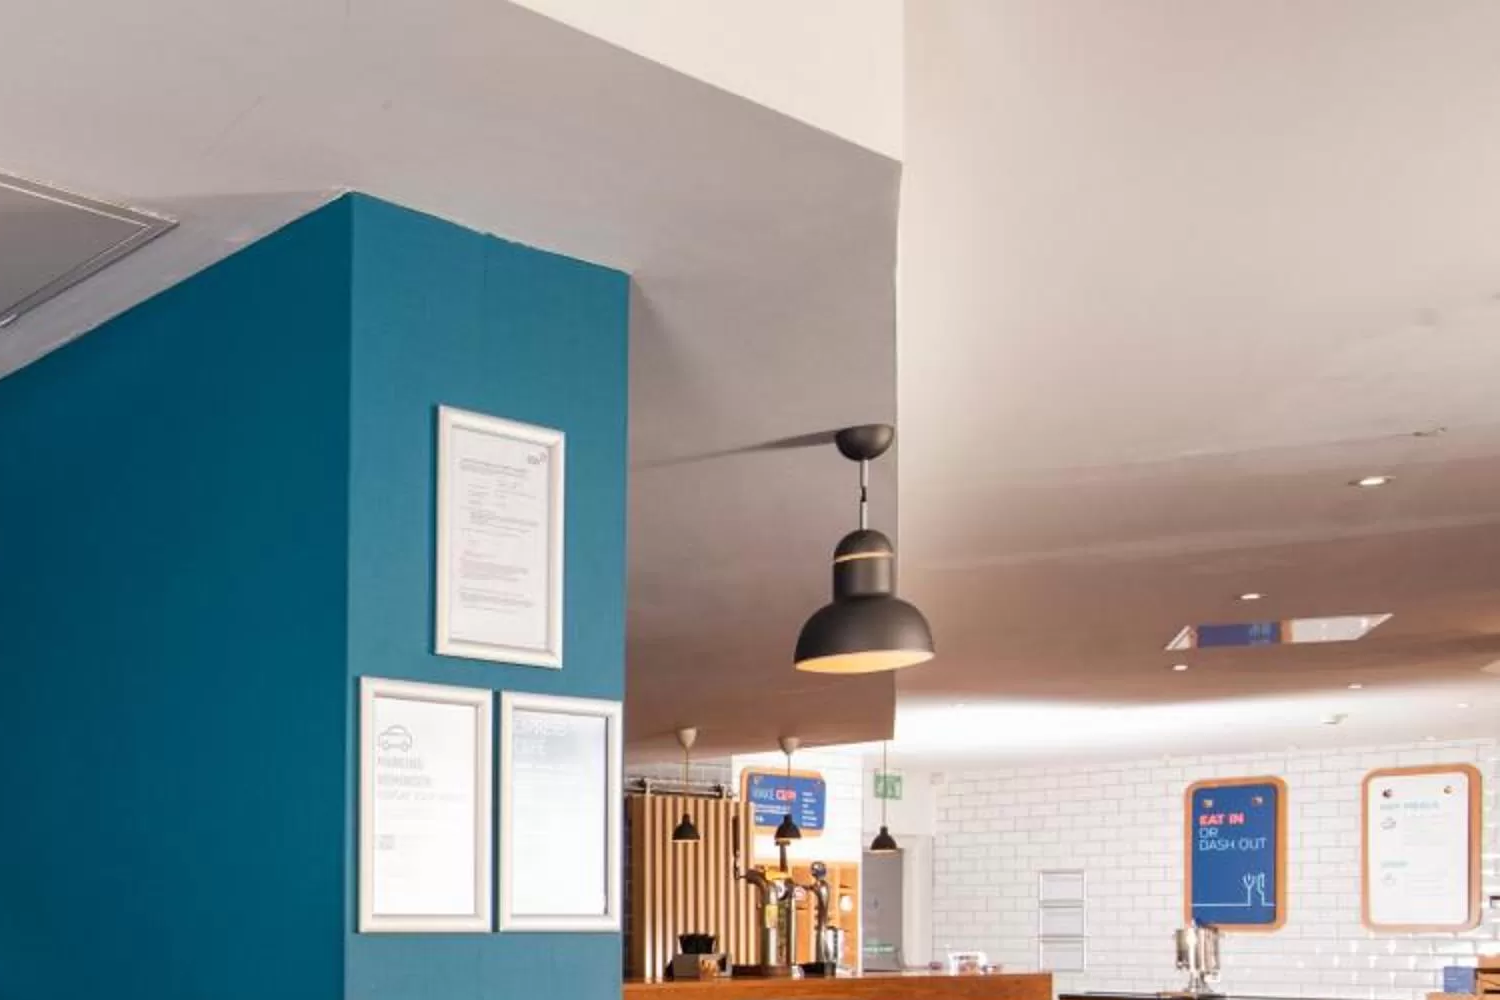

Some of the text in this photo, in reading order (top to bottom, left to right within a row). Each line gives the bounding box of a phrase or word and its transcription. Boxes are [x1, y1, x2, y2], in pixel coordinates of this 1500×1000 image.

[1199, 812, 1244, 826] EAT IN
[1199, 827, 1218, 838] OR
[1199, 837, 1267, 851] DASH OUT
